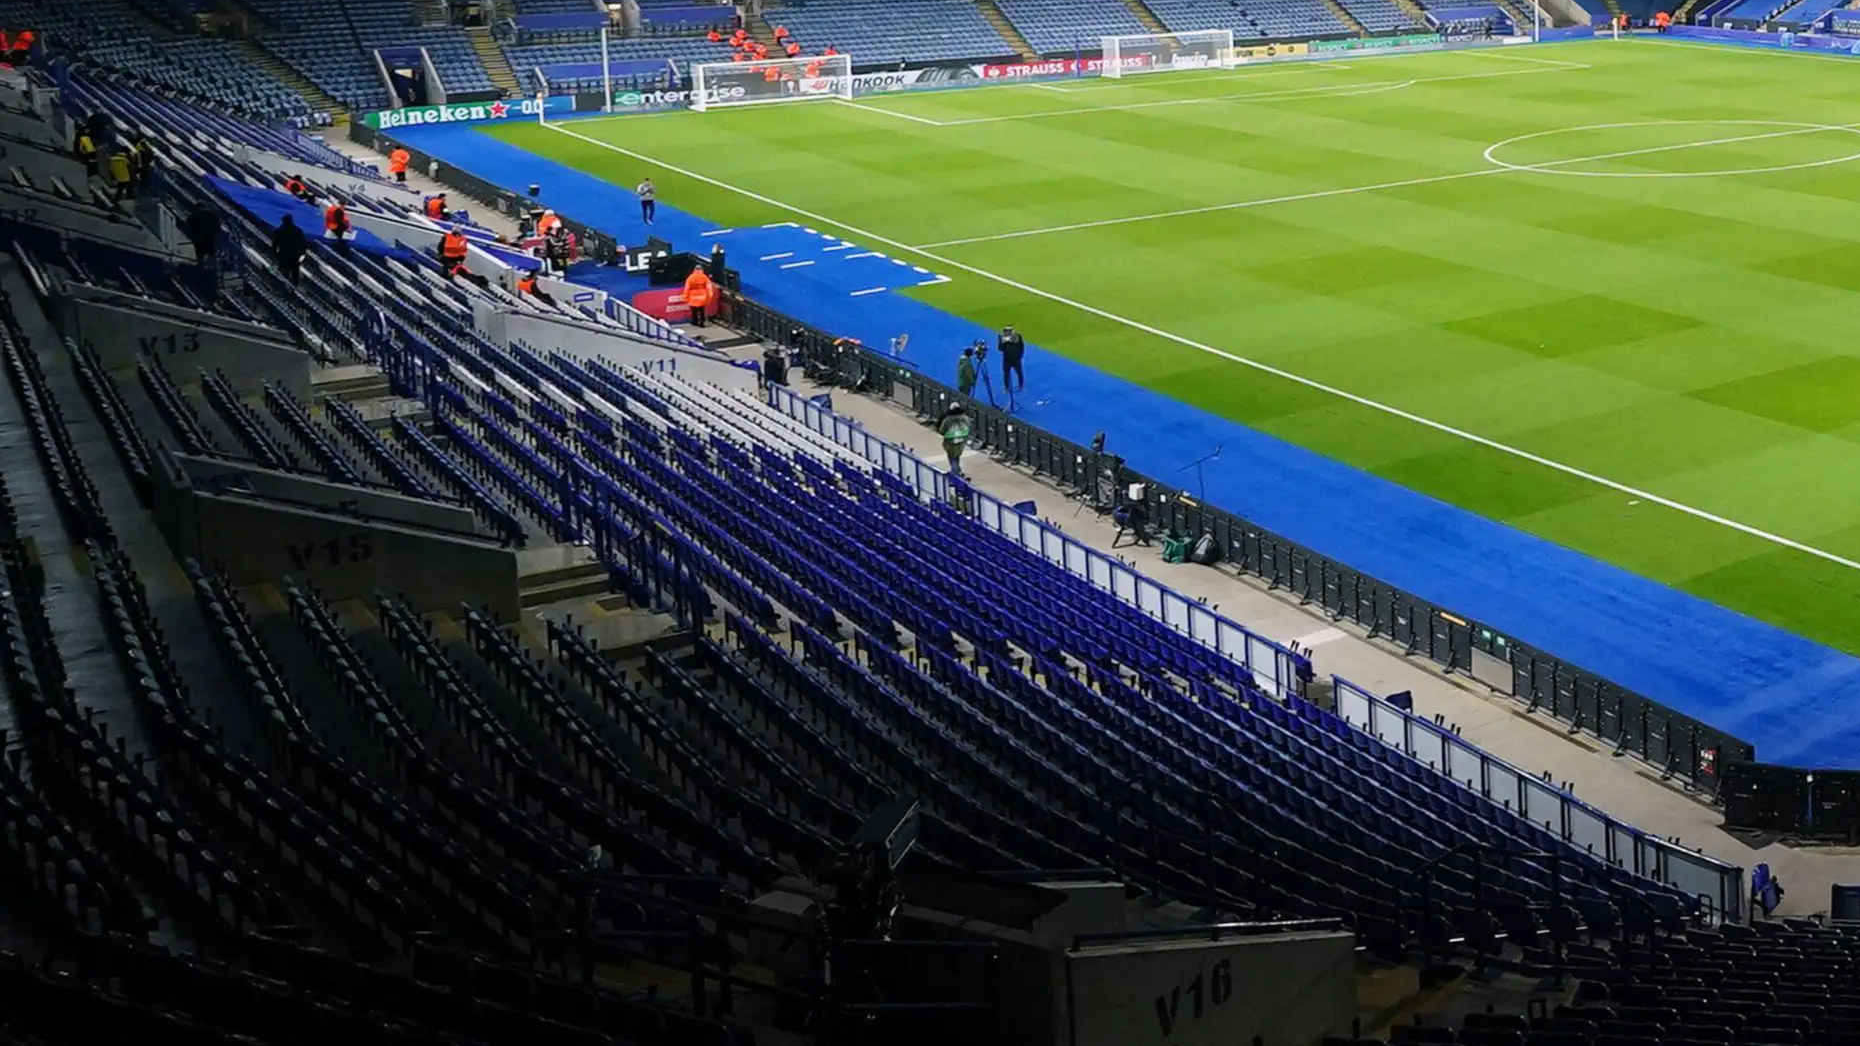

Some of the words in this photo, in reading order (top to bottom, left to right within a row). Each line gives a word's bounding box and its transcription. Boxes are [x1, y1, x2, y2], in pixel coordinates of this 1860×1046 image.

[1006, 61, 1065, 77] STRAUSS
[378, 104, 486, 128] Heineken
[137, 332, 199, 357] V13
[642, 357, 677, 375] V11
[285, 532, 375, 572] V15
[1155, 958, 1233, 1038] V16
